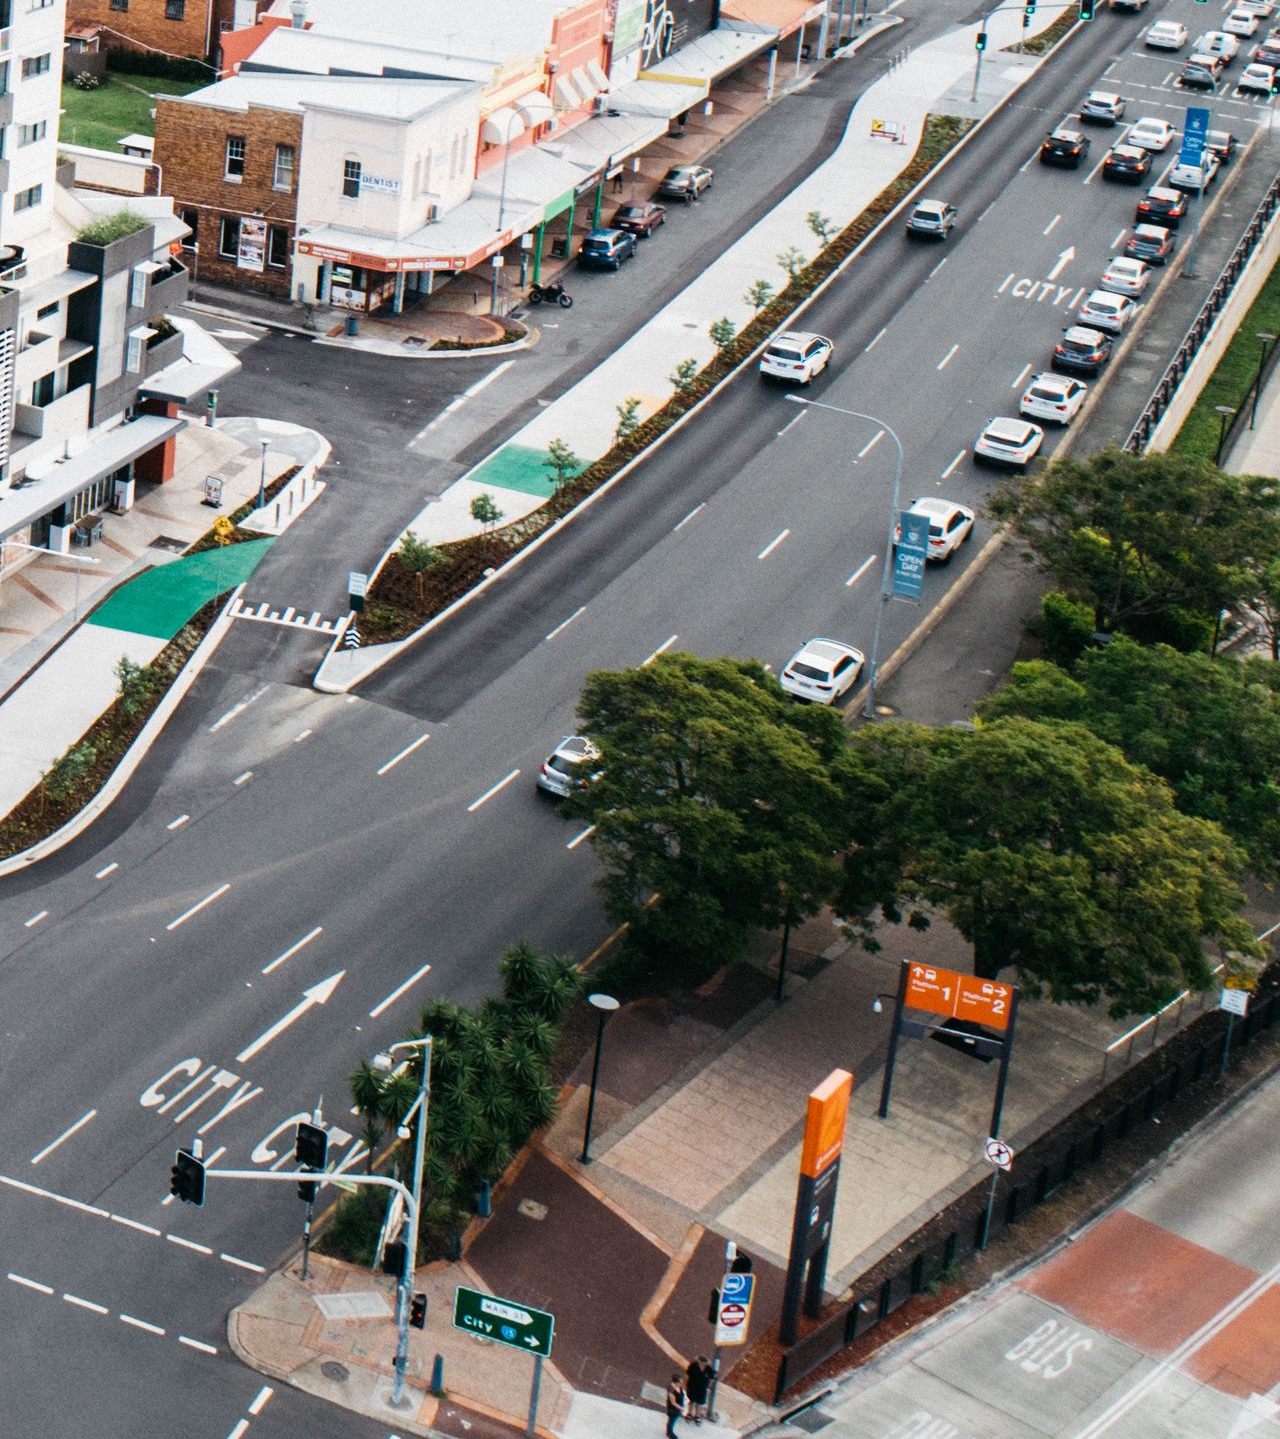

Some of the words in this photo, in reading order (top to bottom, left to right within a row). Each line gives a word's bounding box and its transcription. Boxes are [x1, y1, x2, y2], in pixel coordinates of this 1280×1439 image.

[362, 176, 399, 189] DENTIST
[1012, 278, 1073, 306] CITY
[898, 553, 923, 565] OPEN
[901, 562, 919, 572] DAY
[942, 987, 951, 1002] 1
[992, 999, 1006, 1014] 2
[139, 1057, 264, 1135] CITY
[484, 1302, 508, 1316] MAIN
[463, 1314, 493, 1333] City
[1005, 1318, 1093, 1380] BUS
